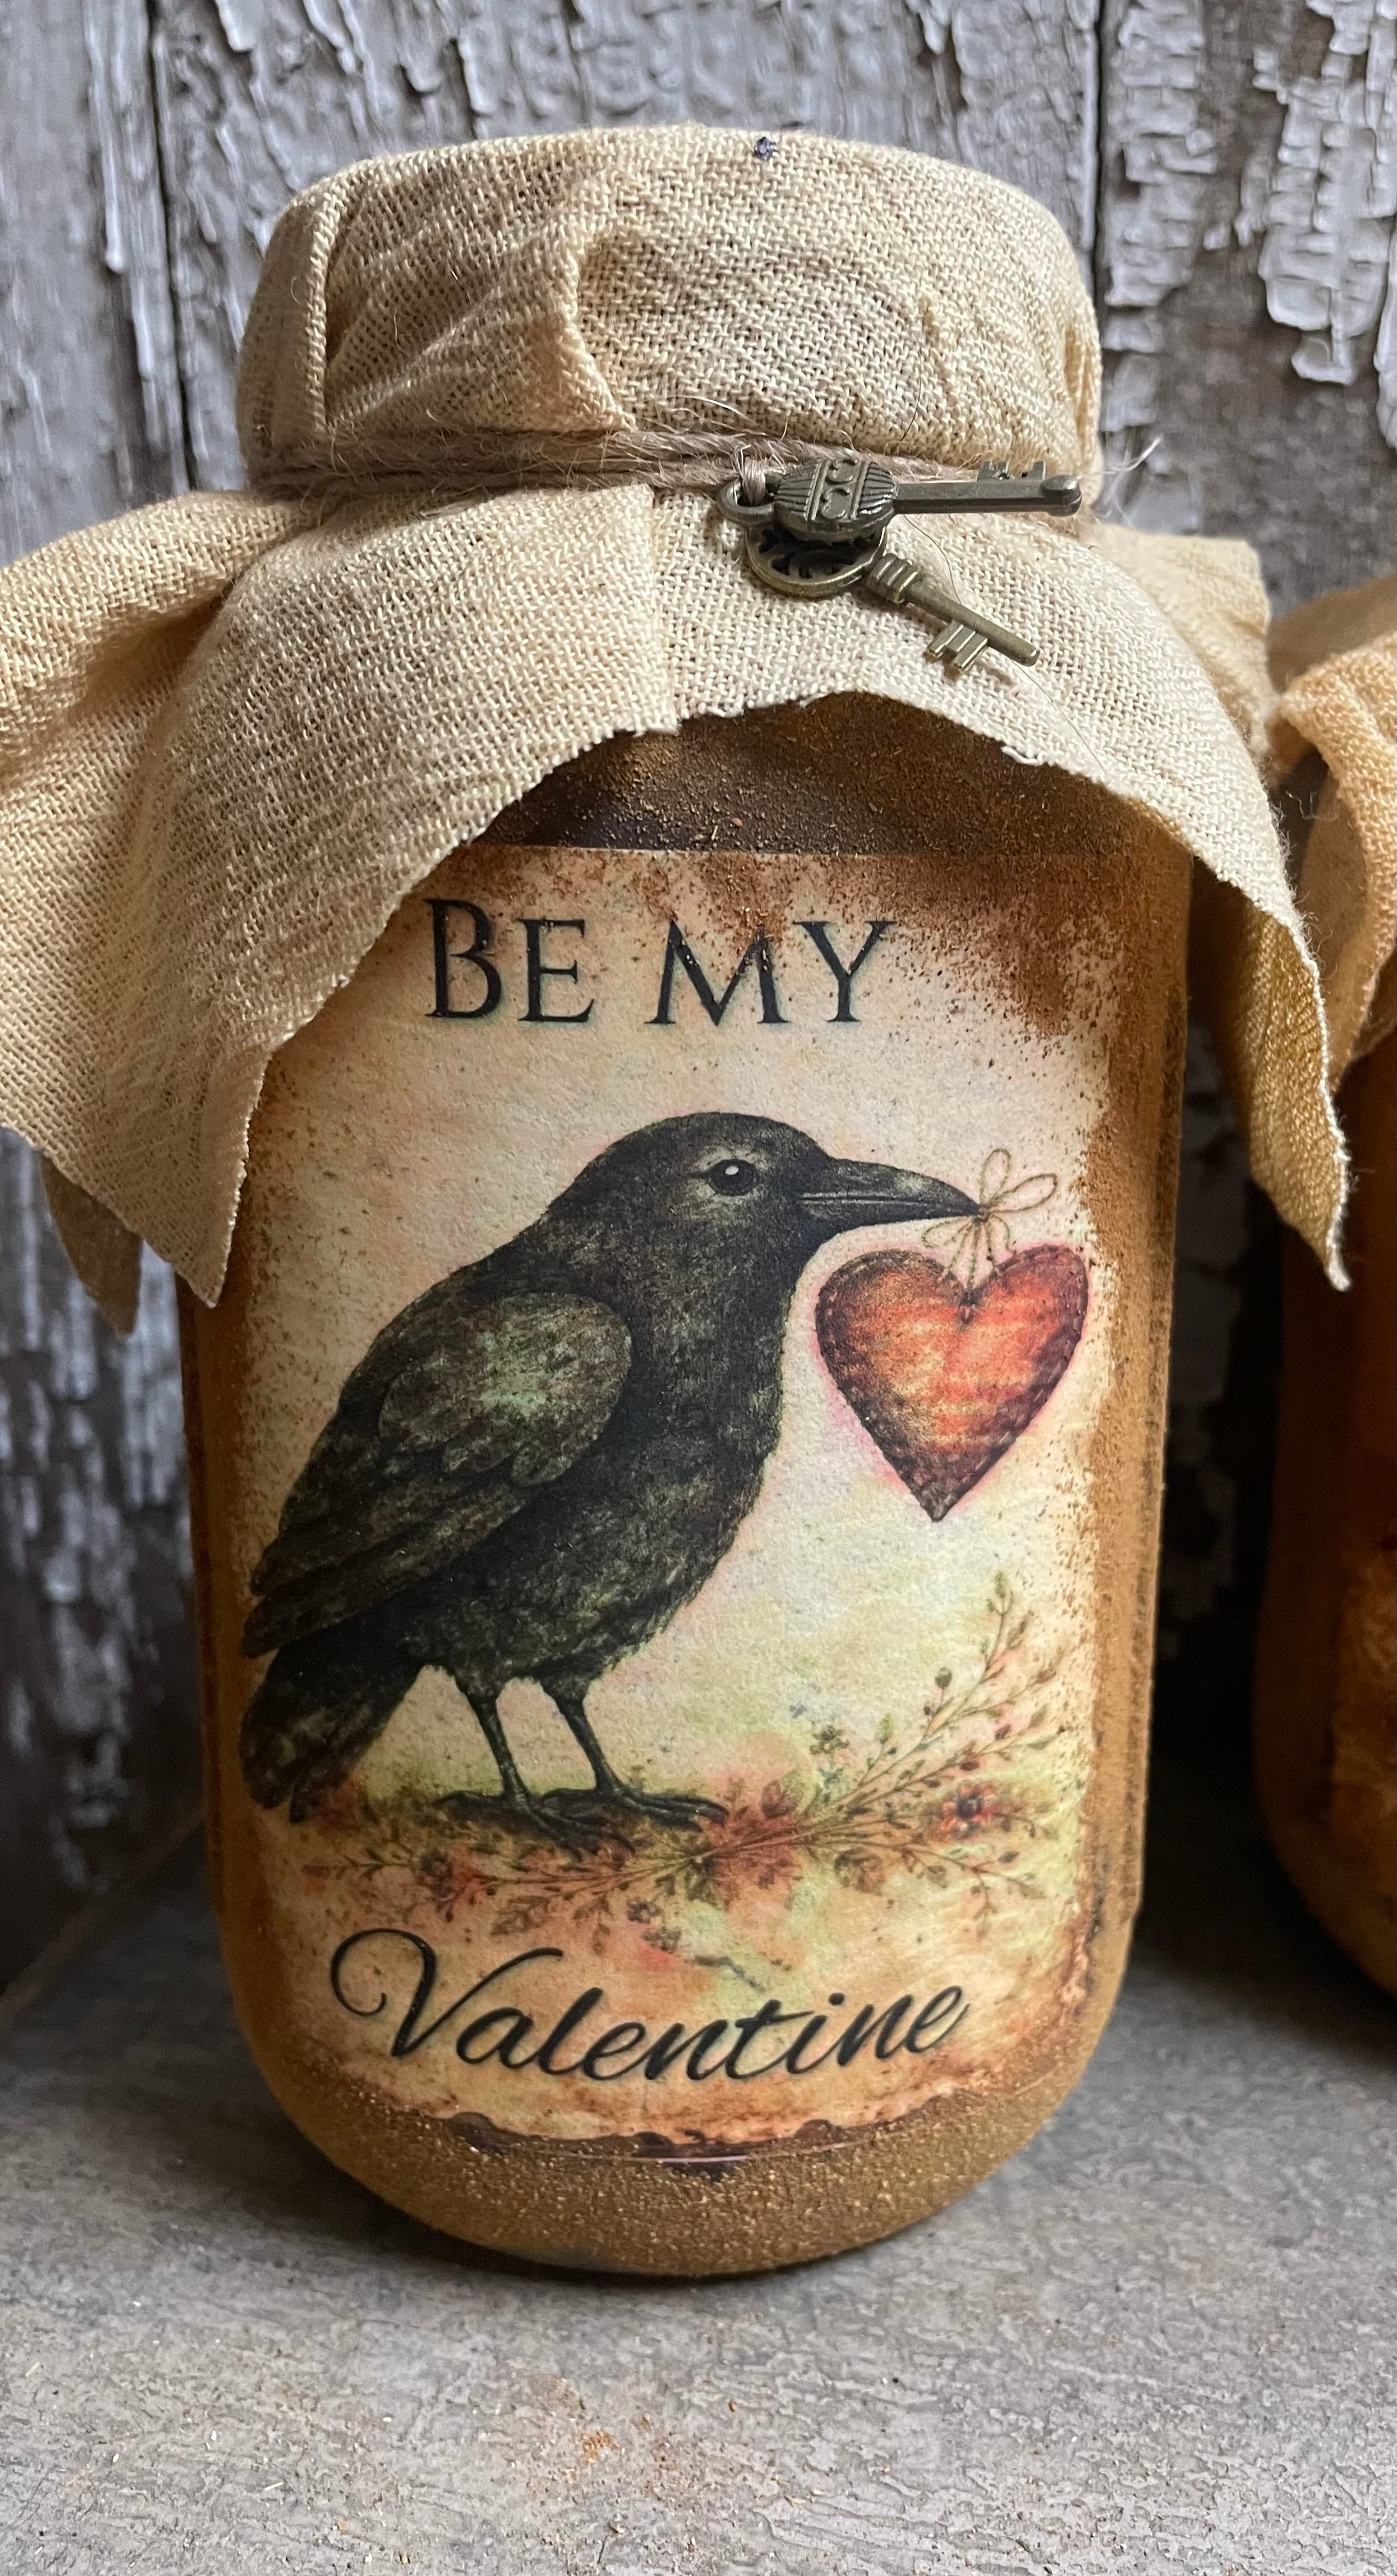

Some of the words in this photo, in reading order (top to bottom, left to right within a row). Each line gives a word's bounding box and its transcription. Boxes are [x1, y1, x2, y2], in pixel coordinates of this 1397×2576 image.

[423, 898, 595, 1023] BE
[644, 919, 896, 1026] MY
[330, 1928, 970, 2082] Valentine
